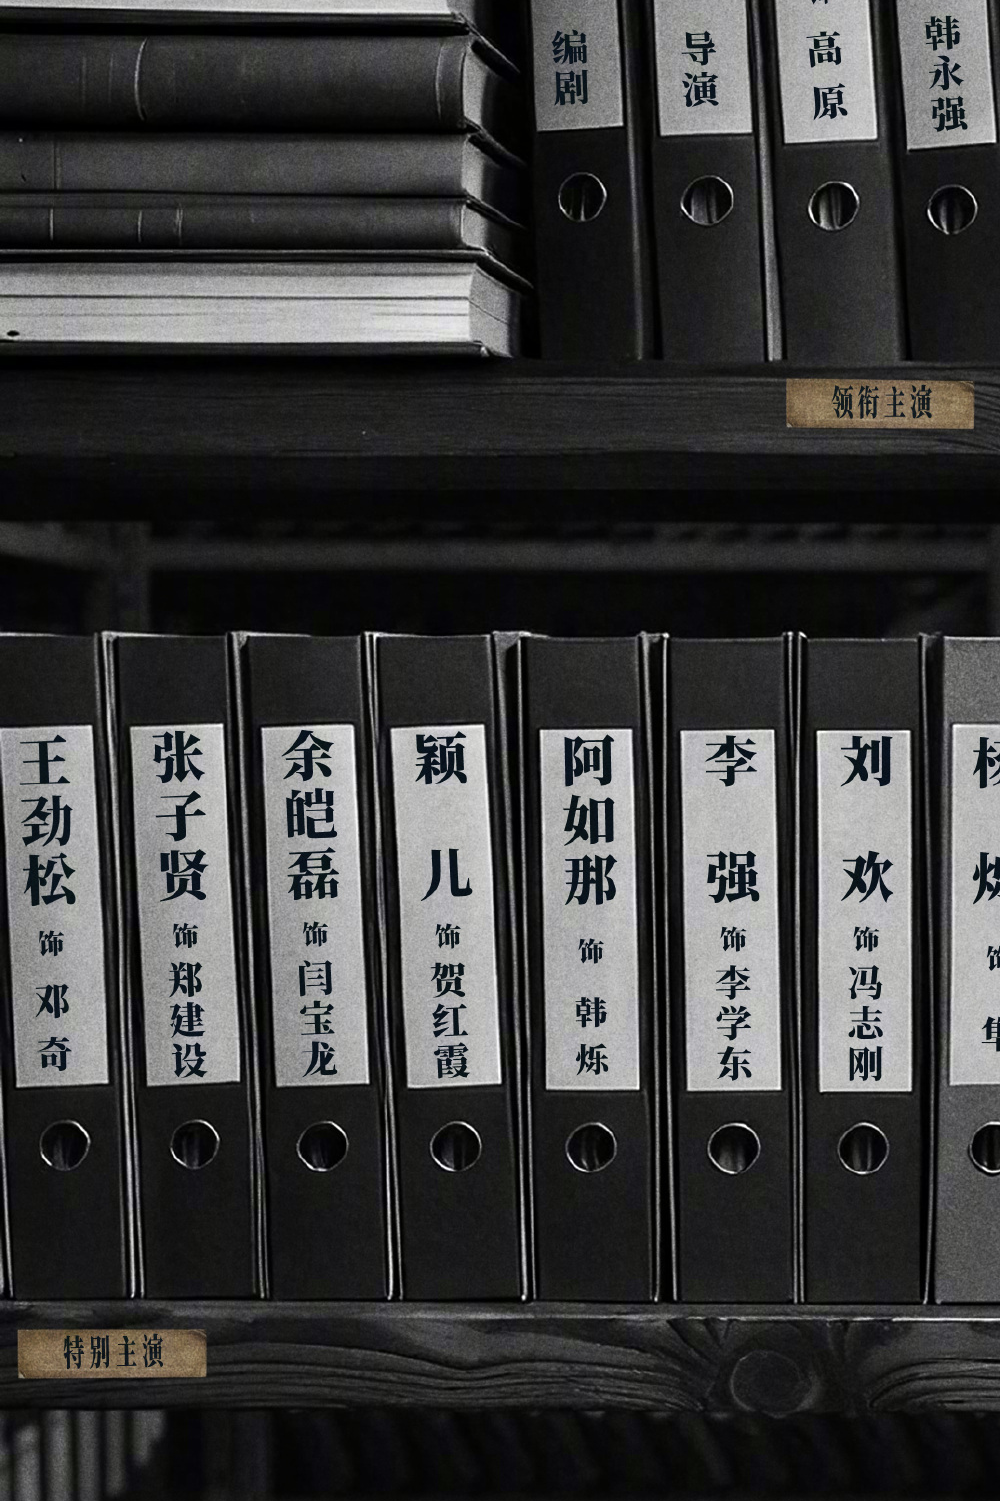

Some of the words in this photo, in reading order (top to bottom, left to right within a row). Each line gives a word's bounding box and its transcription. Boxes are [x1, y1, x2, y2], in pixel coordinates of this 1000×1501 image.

[552, 30, 588, 105] 编剧
[682, 31, 718, 107] 导演
[807, 32, 847, 120] 高原
[925, 16, 967, 132] 韩永强
[831, 383, 933, 420] 领衔主演
[20, 735, 75, 906] 王劲松
[153, 731, 208, 902] 张子贤
[279, 727, 339, 900] 余皑磊
[416, 732, 472, 901] 颖儿
[563, 735, 617, 905] 阿如那
[706, 735, 759, 903] 李强
[841, 736, 893, 902] 刘欢
[39, 931, 63, 956] 饰
[173, 923, 198, 948] 饰
[303, 922, 328, 946] 饰
[436, 924, 460, 948] 饰
[579, 939, 603, 963] 饰
[721, 927, 746, 951] 饰
[854, 927, 879, 952] 饰
[36, 984, 71, 1071] 邓奇
[169, 962, 207, 1078] 郑建设
[299, 961, 337, 1077] 闫宝龙
[431, 963, 469, 1078] 贺红霞
[576, 997, 608, 1075] 韩烁
[716, 965, 751, 1081] 李学东
[849, 965, 883, 1081] 冯志刚
[64, 1334, 163, 1369] 特别主演
